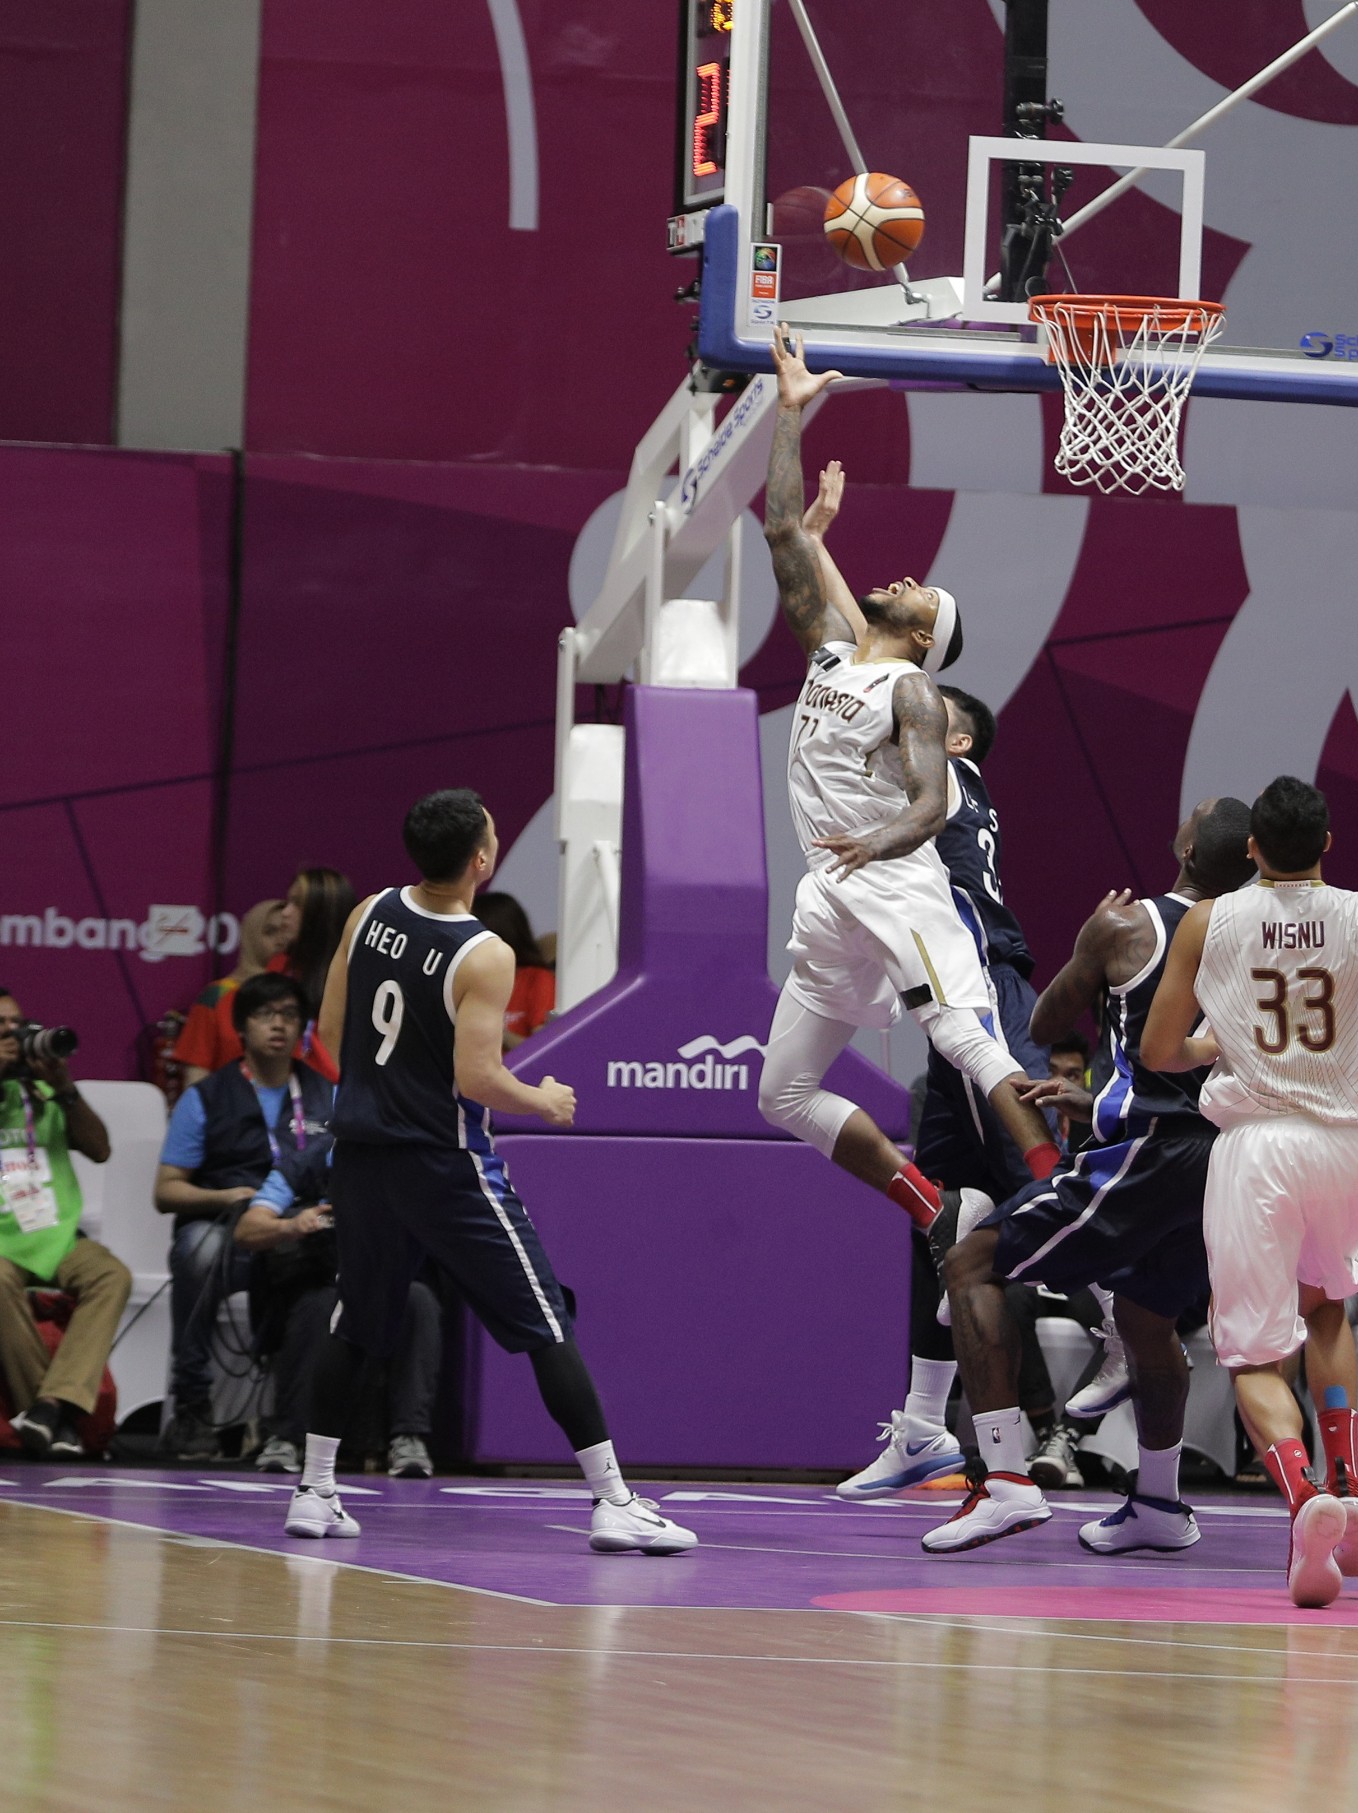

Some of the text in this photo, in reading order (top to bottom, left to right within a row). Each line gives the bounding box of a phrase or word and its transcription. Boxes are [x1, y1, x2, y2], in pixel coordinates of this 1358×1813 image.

[364, 919, 444, 976] HEO U
[1261, 920, 1326, 950] WISNU
[371, 979, 405, 1066] 9
[1250, 966, 1336, 1056] 33
[607, 1054, 748, 1090] mandiri
